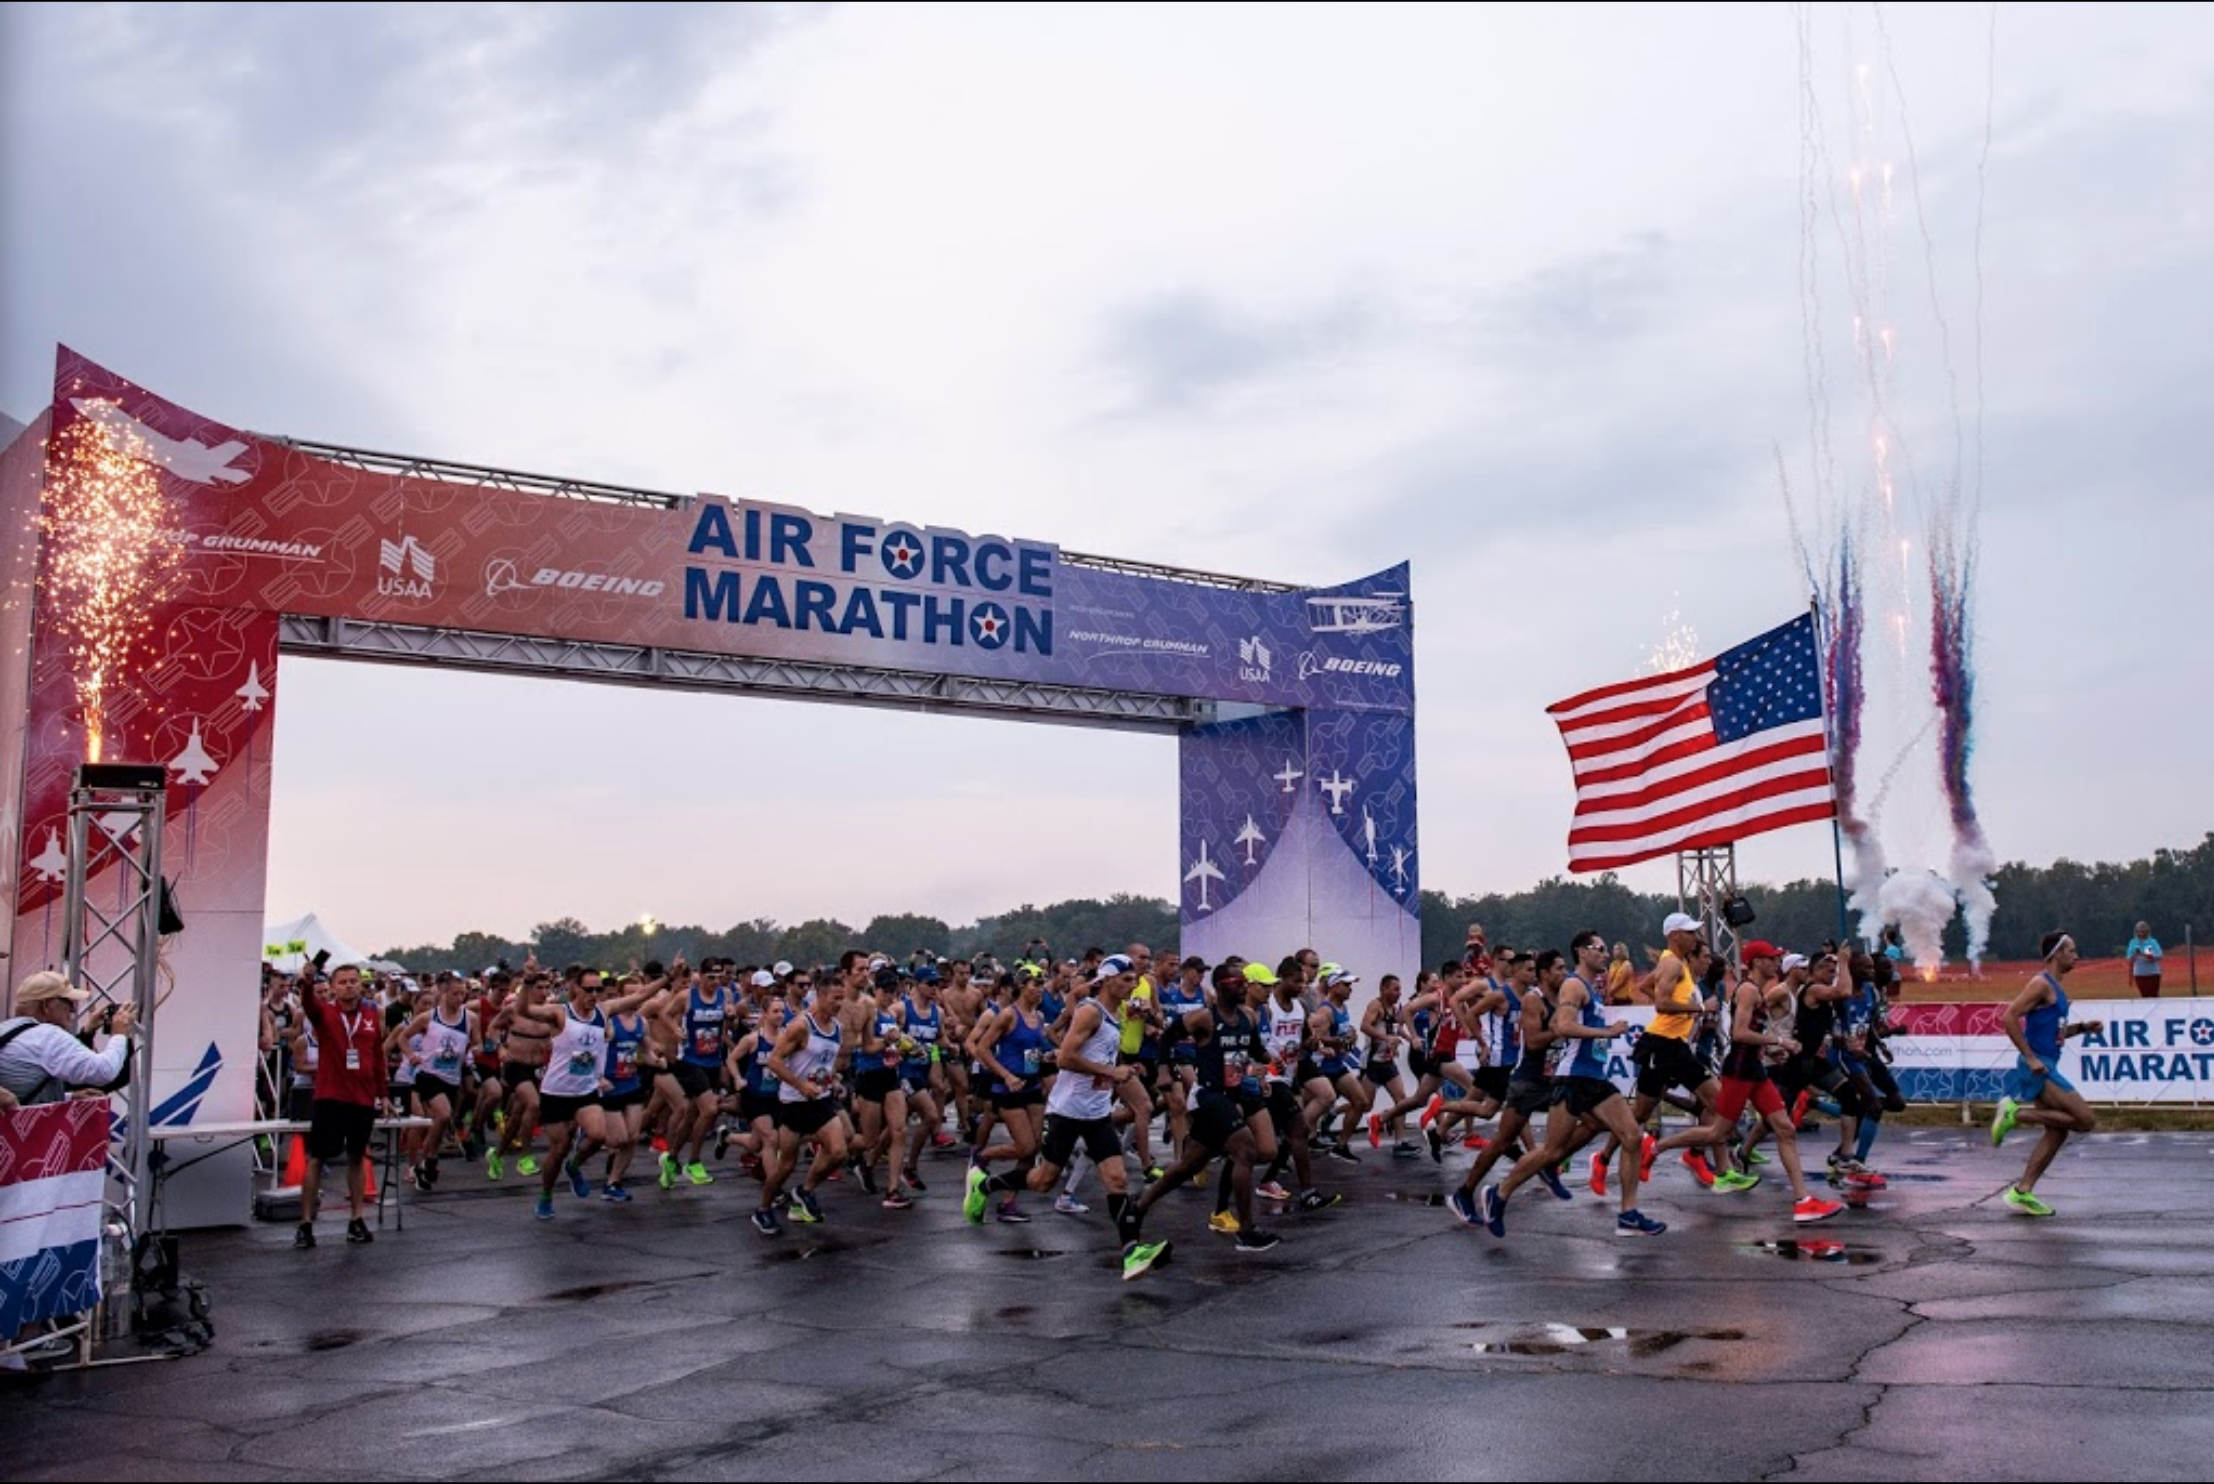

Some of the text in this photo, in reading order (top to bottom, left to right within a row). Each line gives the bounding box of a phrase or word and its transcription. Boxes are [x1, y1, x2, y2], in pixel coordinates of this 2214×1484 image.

[202, 535, 322, 557] GRUMMAN
[687, 503, 1053, 597] AIR FORCE
[378, 577, 432, 598] USAA
[530, 567, 665, 597] BOEING
[684, 566, 1054, 656] MARATHON
[1069, 630, 1142, 646] NORTHROP
[1240, 667, 1270, 683] USAA
[1323, 657, 1402, 677] BOEING
[2081, 1053, 2214, 1082] MARAT
